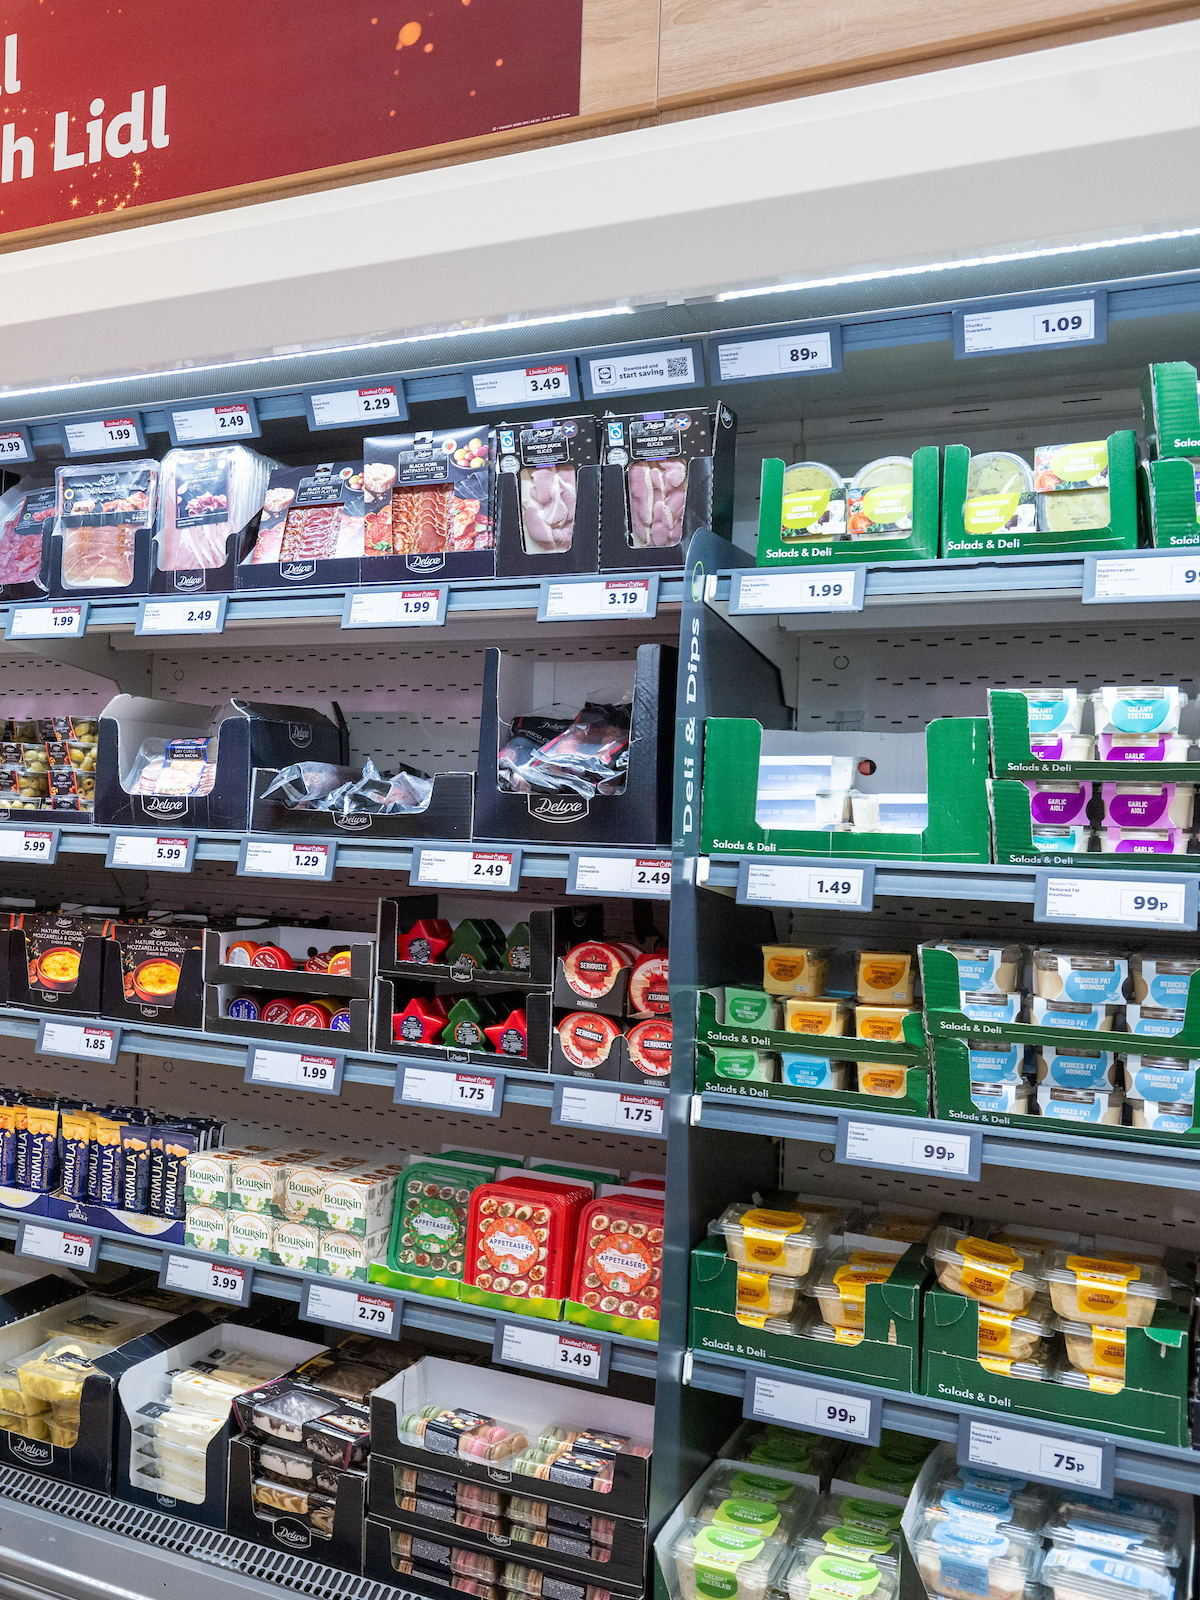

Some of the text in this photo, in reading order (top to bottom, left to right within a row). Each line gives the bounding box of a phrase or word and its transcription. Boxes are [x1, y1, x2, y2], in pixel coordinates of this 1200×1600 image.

[52, 84, 171, 171] Lidl
[1042, 315, 1082, 333] 1.09
[790, 348, 818, 362] 89p
[529, 366, 563, 375] Limited Offer
[619, 368, 664, 380] start saving
[531, 377, 561, 391] 3.49
[363, 398, 390, 411] 2.29
[219, 416, 245, 428] 2.49
[109, 429, 130, 440] 1.99
[0, 441, 20, 453] 2.99
[948, 538, 1020, 551] Salads & Deli
[766, 548, 832, 558] Salads & Deli
[412, 555, 442, 569] Deluxe
[808, 584, 843, 597] 1.99
[608, 592, 637, 605] 3.19
[404, 601, 430, 614] 1.99
[53, 616, 73, 627] 1.99
[187, 610, 211, 621] 2.49
[1127, 712, 1153, 720] TZATZIKI
[682, 617, 700, 836] Deli & Dips
[1008, 763, 1072, 772] Salads & Deli
[146, 797, 183, 813] Deluxe
[535, 799, 583, 814] Deluxe
[24, 841, 46, 852] 5.99
[713, 839, 777, 852] Salads & Deli
[157, 848, 180, 859] 5.99
[295, 855, 319, 867] 1.29
[474, 863, 504, 877] 2.49
[637, 871, 670, 884] 2.49
[817, 880, 852, 894] 1.49
[1133, 896, 1168, 911] 99p
[135, 939, 156, 947] MATURE
[1074, 976, 1099, 984] REDUCED
[85, 1037, 106, 1050] 1.85
[1060, 1061, 1084, 1069] REDUCED
[302, 1067, 327, 1080] 1.99
[1065, 1069, 1091, 1077] HOUMOUS
[459, 1086, 485, 1101] 1.75
[624, 1107, 653, 1123] 1.75
[924, 1145, 955, 1160] 99p
[31, 1136, 44, 1190] PRIMULA
[64, 1143, 77, 1196] PRIMULA
[102, 1148, 115, 1202] PRIMULA
[124, 1154, 137, 1209] PRIMULA
[188, 1168, 225, 1184] Boursin
[164, 1160, 179, 1216] PRIMULA
[235, 1176, 273, 1193] Boursin
[324, 1193, 363, 1211] Boursin
[188, 1215, 224, 1232] Boursin
[414, 1217, 455, 1233] APPETEASERS
[231, 1225, 269, 1241] Boursin
[64, 1243, 85, 1257] 2.19
[489, 1236, 534, 1252] APPETEASERS
[600, 1254, 647, 1270] APPETEASERS
[212, 1275, 237, 1291] 3.99
[974, 1277, 993, 1287] CHEESE
[360, 1295, 392, 1308] Limited Offer
[358, 1306, 386, 1323] 2.79
[562, 1337, 597, 1351] Limited Offer
[560, 1349, 592, 1367] 3.49
[827, 1406, 856, 1424] 99p
[13, 1438, 50, 1458] Deluxe
[1054, 1453, 1085, 1472] 75p
[278, 1525, 308, 1544] Deluxe
